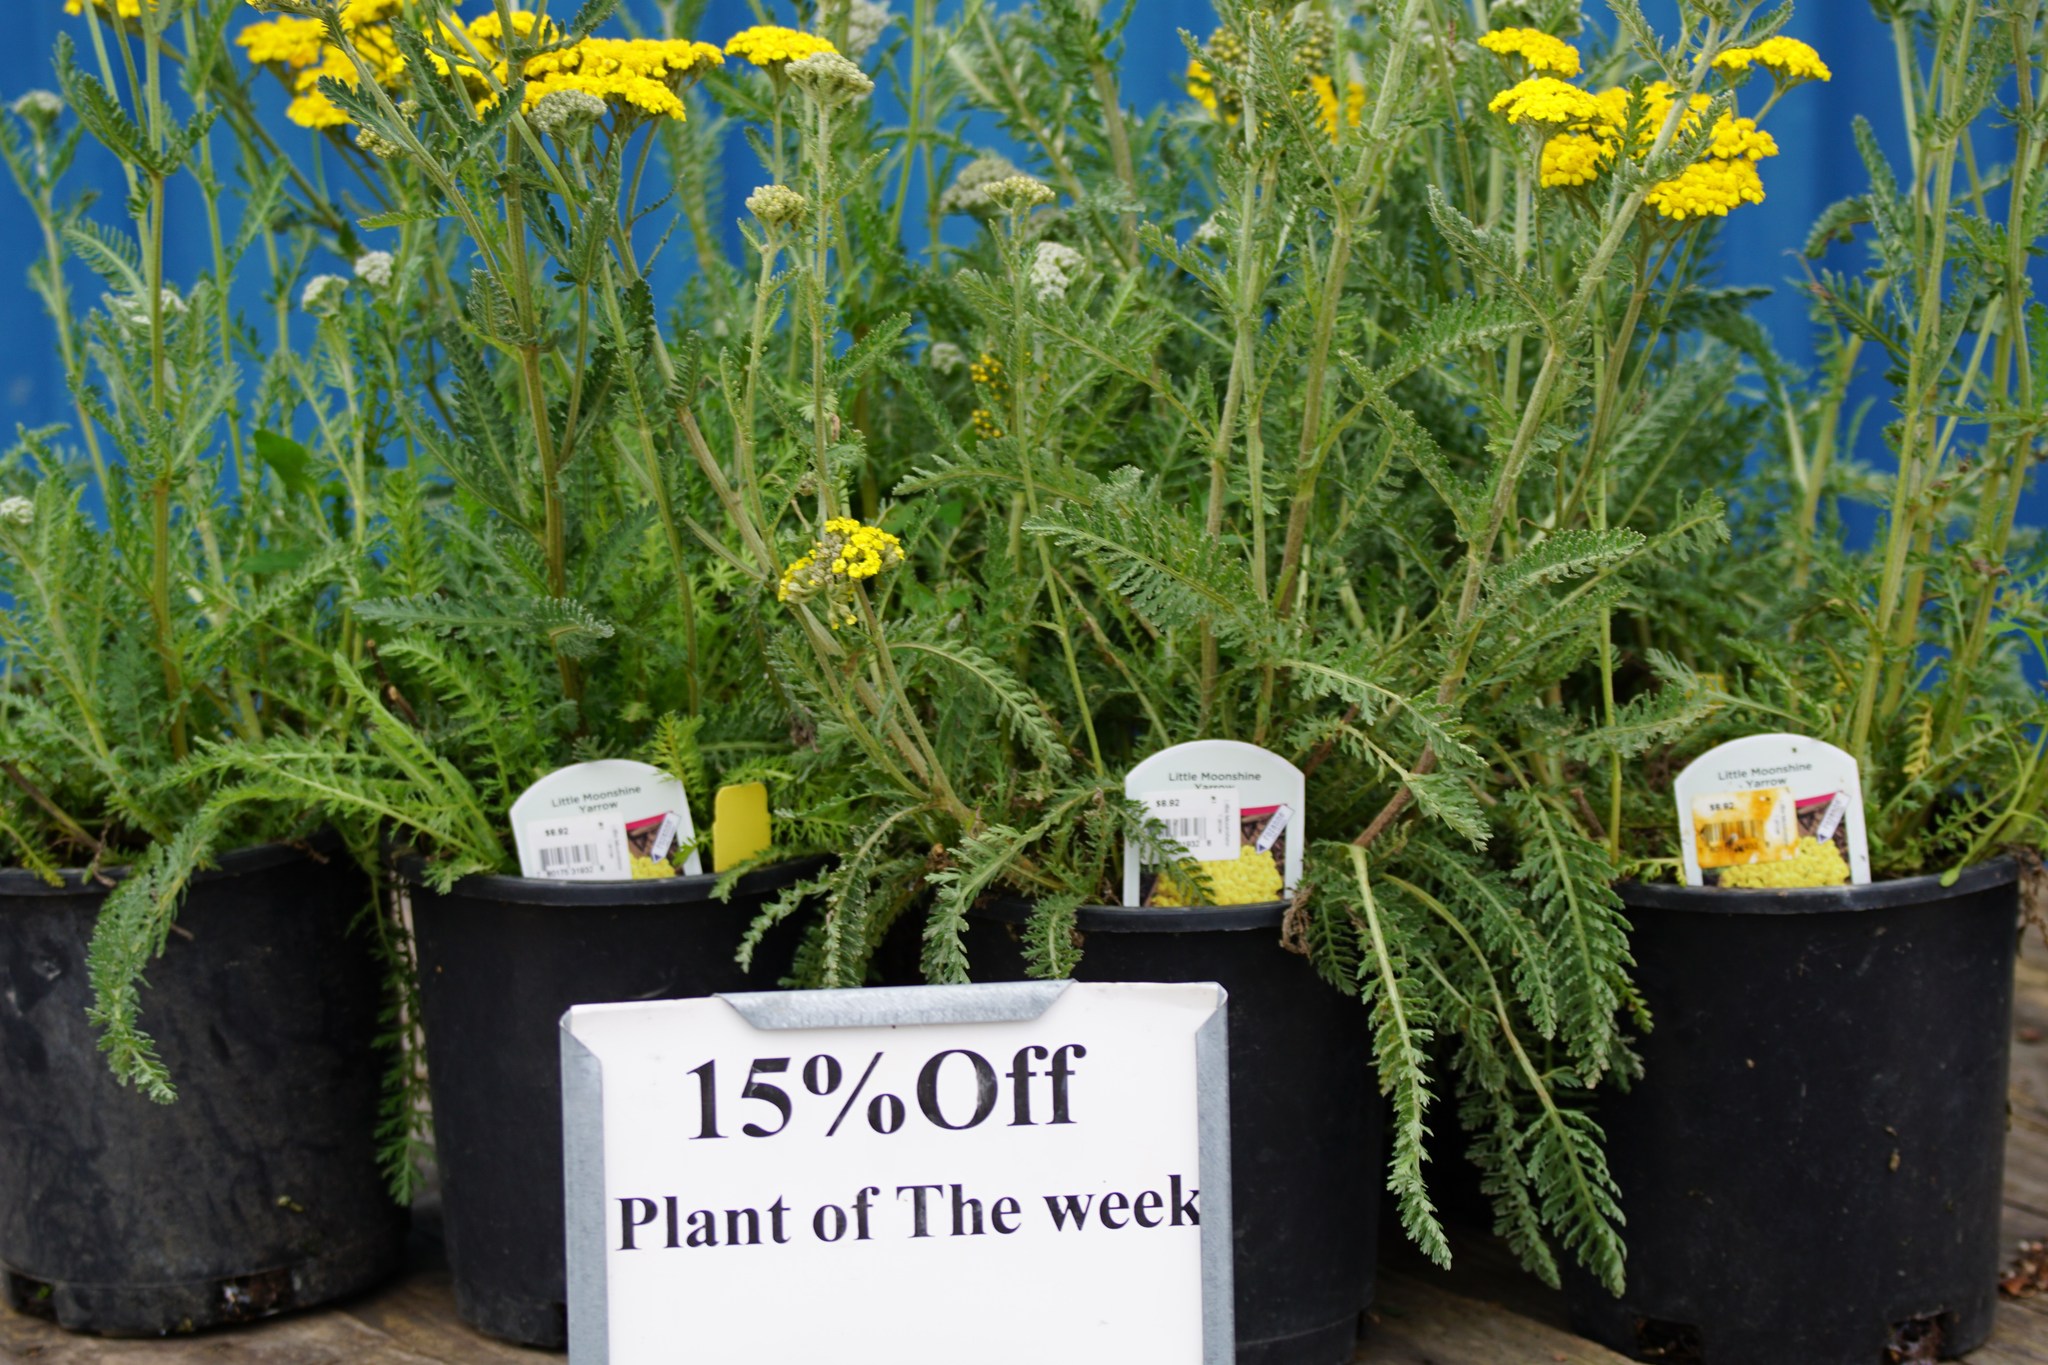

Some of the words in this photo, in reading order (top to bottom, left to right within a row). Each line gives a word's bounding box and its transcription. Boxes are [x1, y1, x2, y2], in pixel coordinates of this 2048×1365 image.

[1168, 772, 1198, 781] Little
[1201, 772, 1262, 781] Moonshine
[1718, 770, 1747, 781] Little
[1751, 763, 1812, 776] Moonshine
[1746, 778, 1787, 788] Yarrow
[552, 796, 580, 808] Little
[583, 786, 641, 801] Moonshine
[1156, 799, 1180, 807] $8.92
[579, 801, 618, 813] Yarrow
[686, 1043, 1087, 1140] 15%Off
[615, 1193, 791, 1251] Plant
[812, 1186, 880, 1243] of
[896, 1183, 1022, 1238] The
[1042, 1174, 1201, 1232] week
